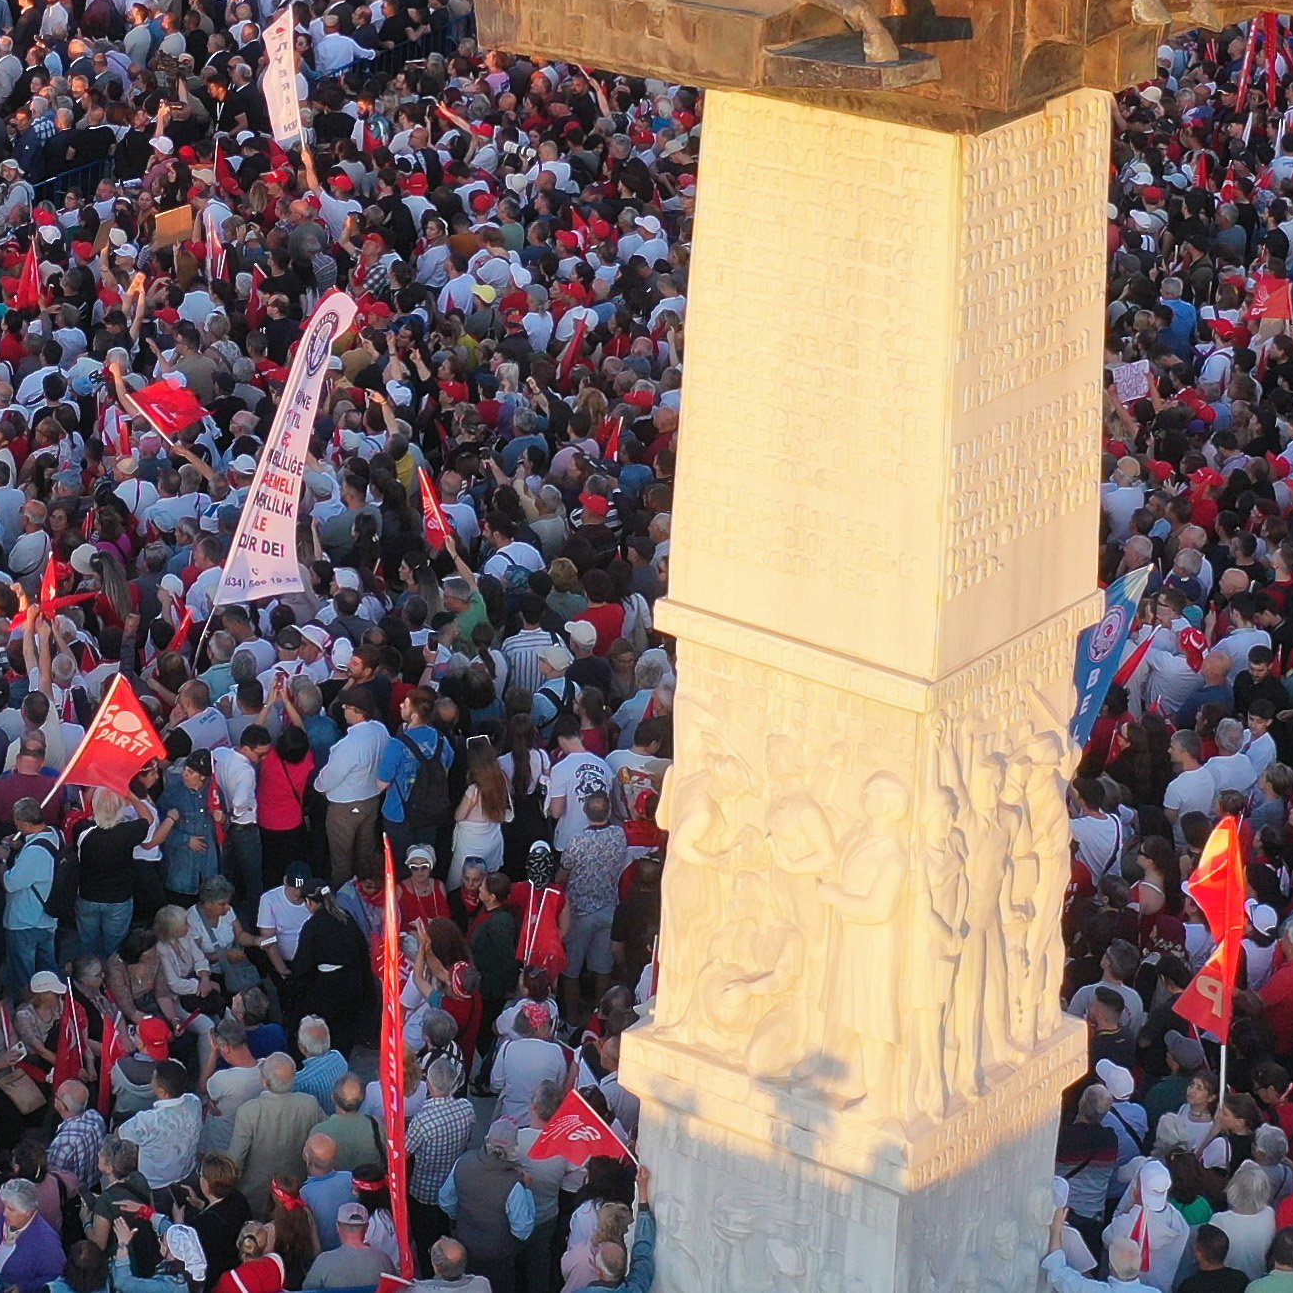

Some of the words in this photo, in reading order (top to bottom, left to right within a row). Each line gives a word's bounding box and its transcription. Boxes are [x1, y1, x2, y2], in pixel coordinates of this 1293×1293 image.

[261, 541, 285, 559] DE!
[98, 704, 154, 748] SOL
[96, 727, 149, 758] PARTİ
